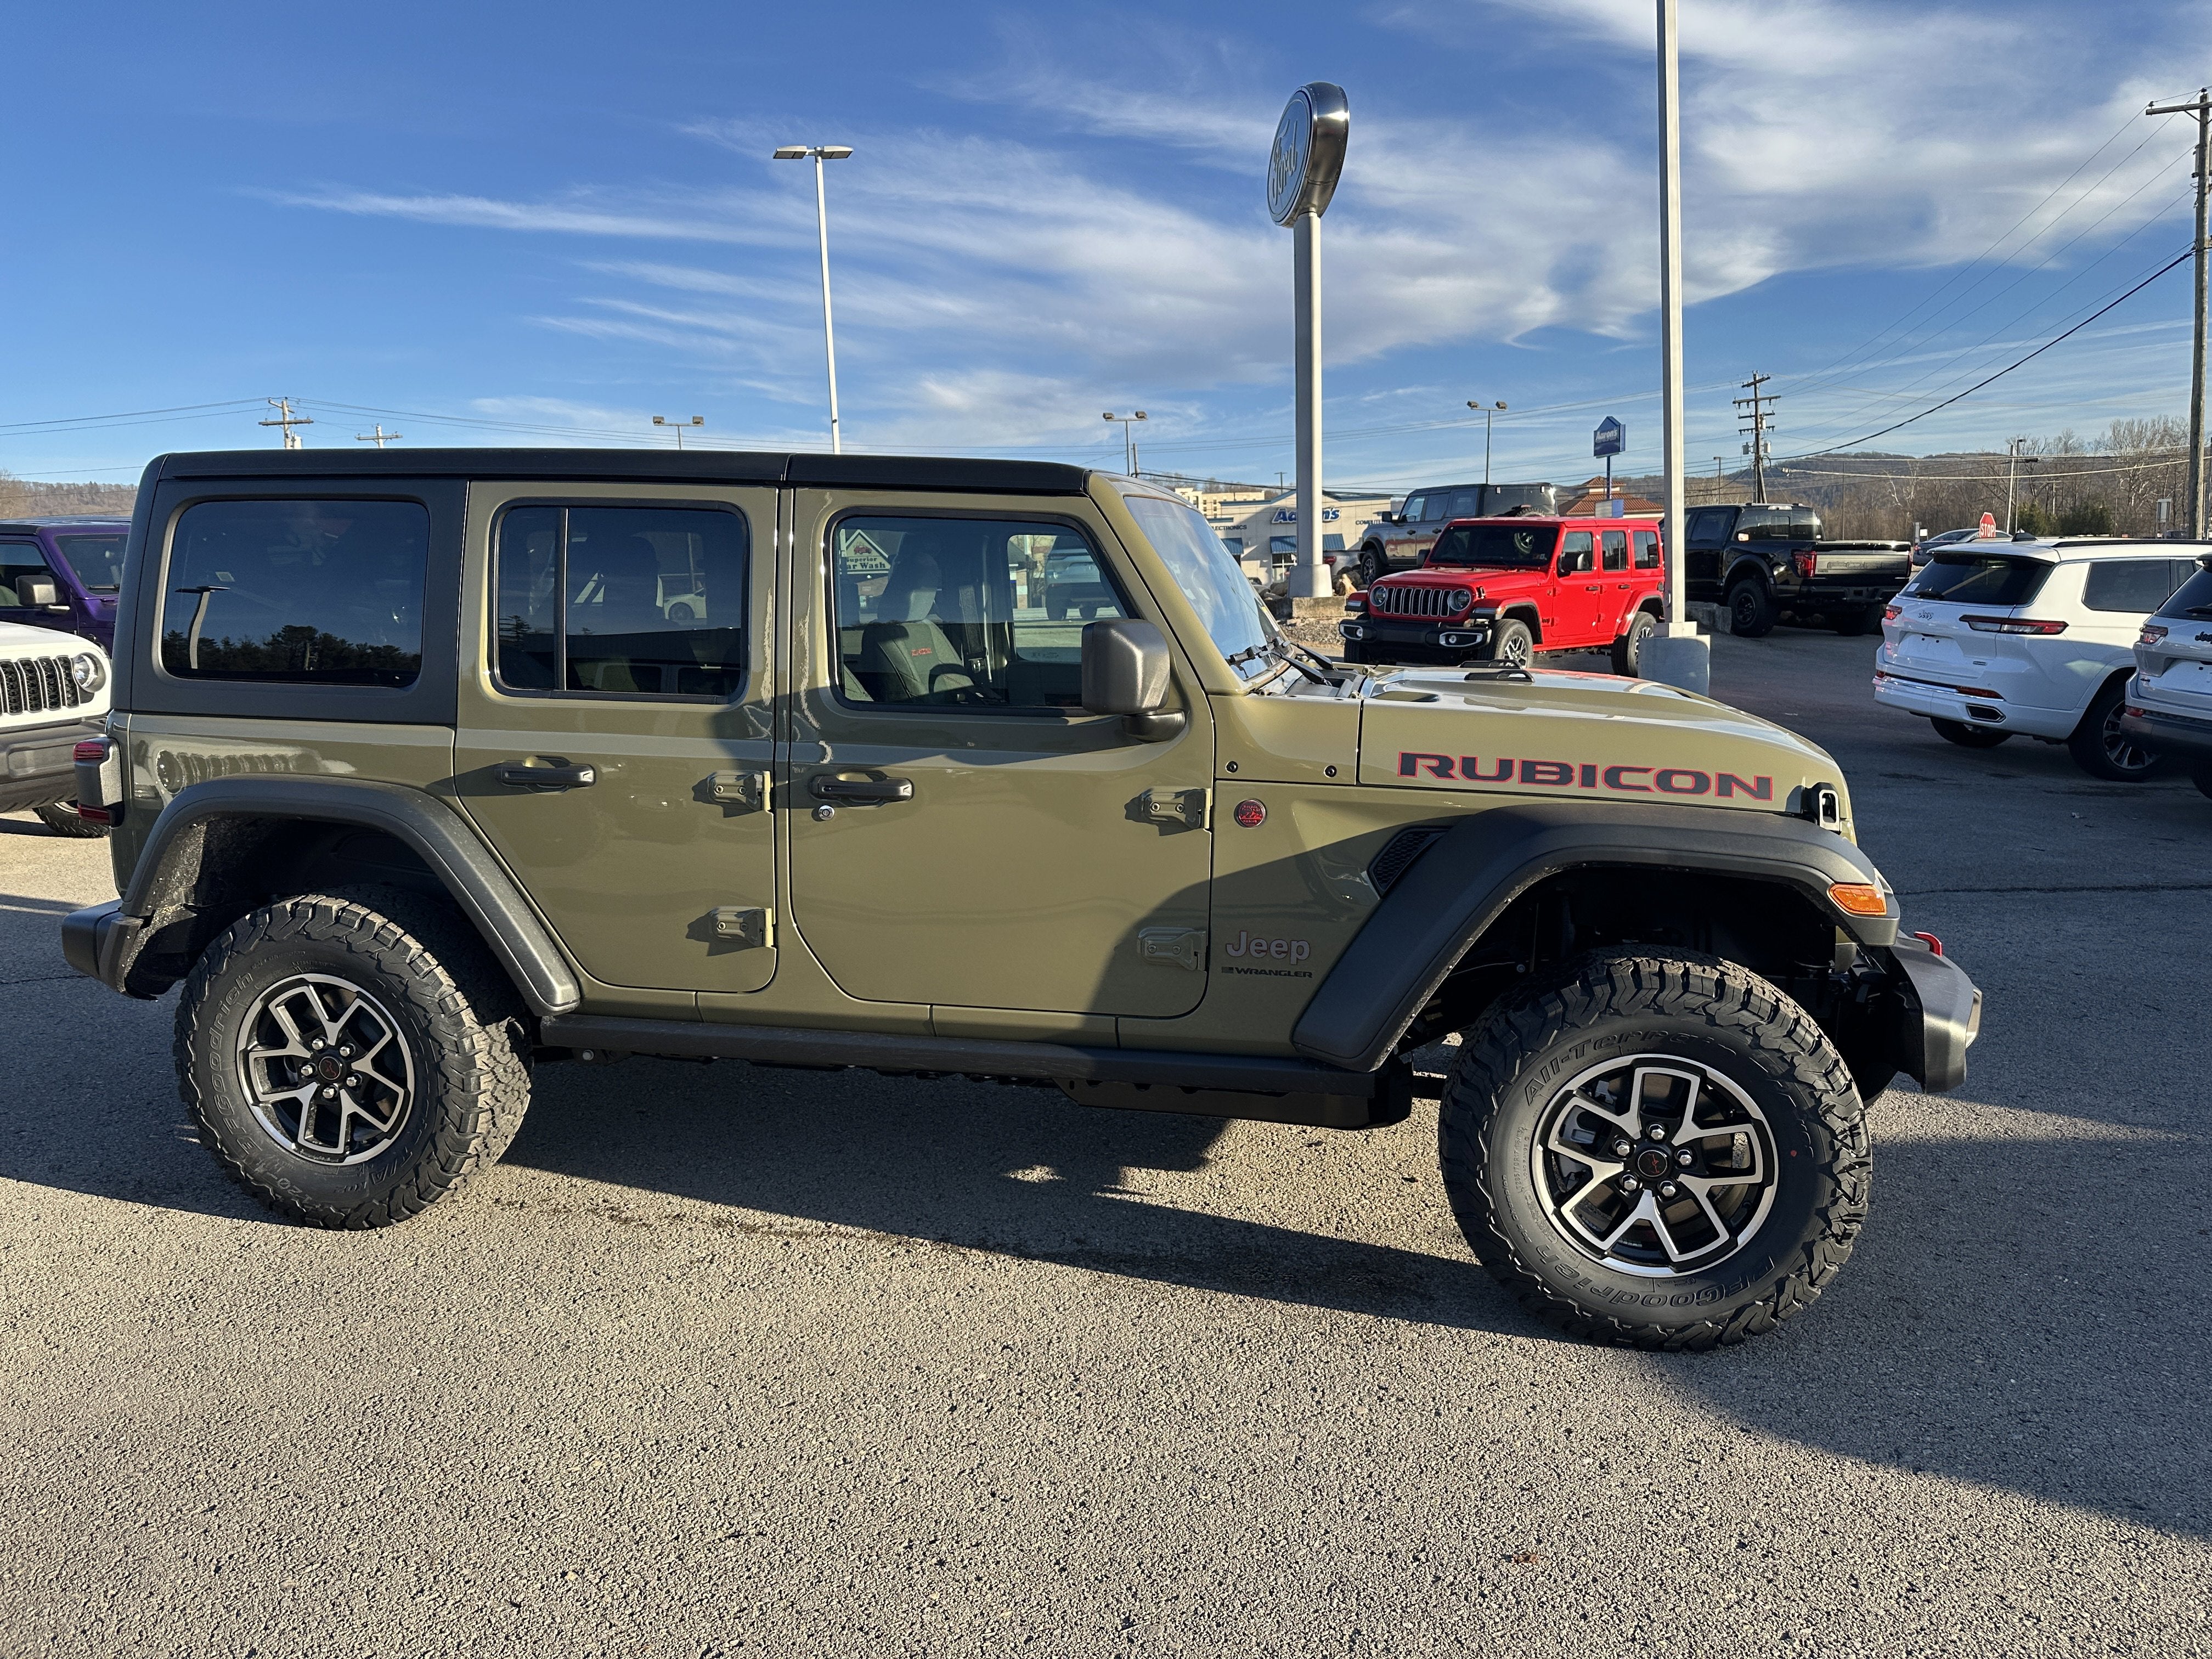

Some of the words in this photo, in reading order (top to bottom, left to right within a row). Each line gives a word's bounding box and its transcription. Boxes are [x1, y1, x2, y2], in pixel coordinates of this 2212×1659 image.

[1272, 118, 1298, 206] Ford
[1272, 506, 1341, 523] Aan's
[1980, 523, 1995, 538] STOP
[1397, 751, 1773, 802] RUBICON
[1226, 930, 1311, 966] Jeep
[1235, 967, 1313, 979] WRANGLER
[209, 973, 263, 1155] BFGoodrich
[1525, 1030, 1737, 1106] All-Terra
